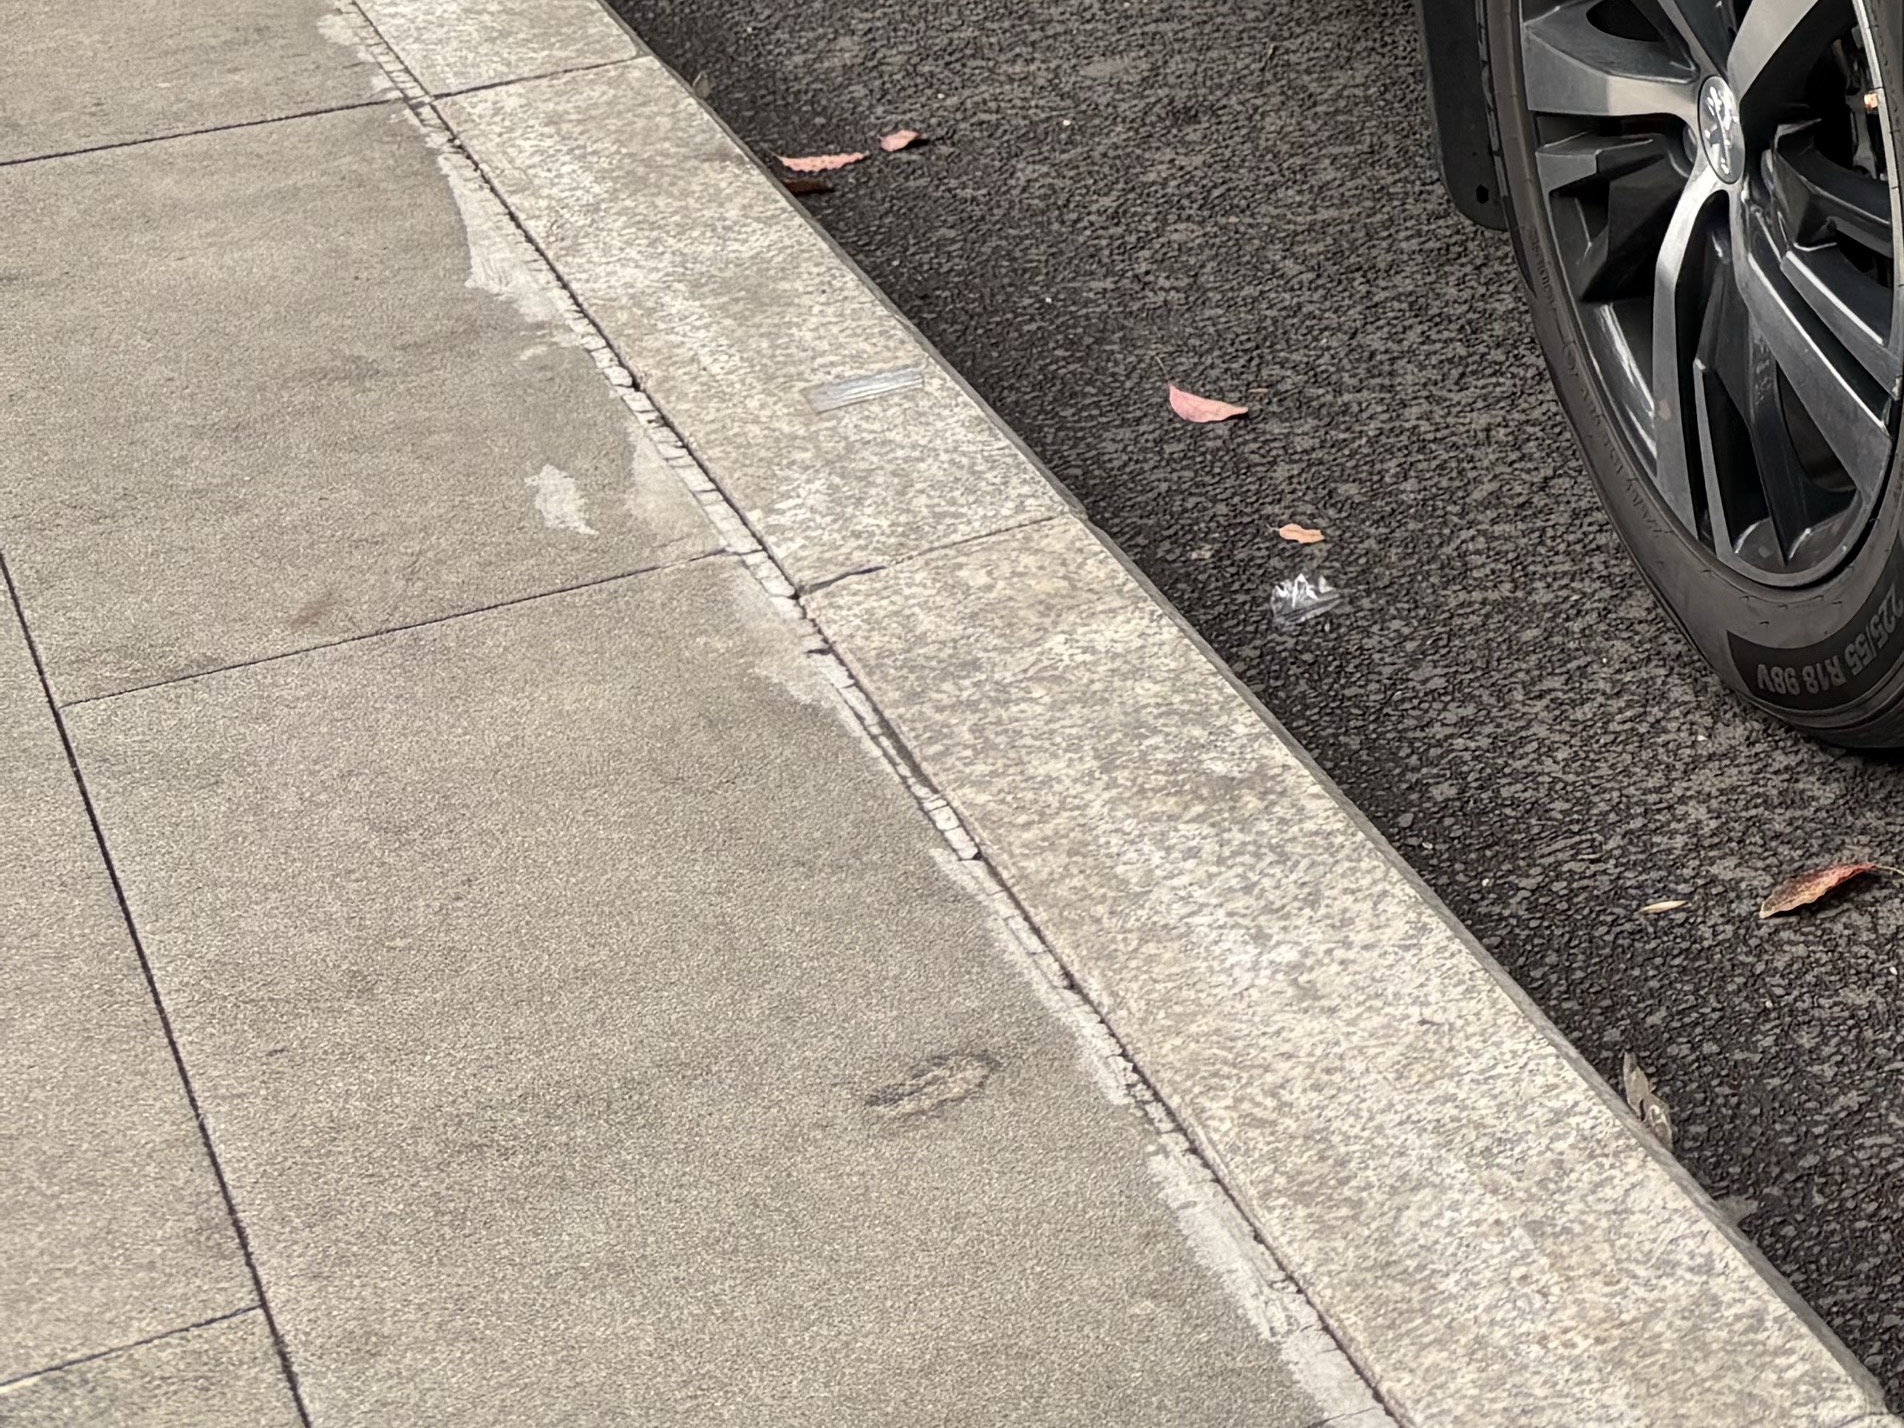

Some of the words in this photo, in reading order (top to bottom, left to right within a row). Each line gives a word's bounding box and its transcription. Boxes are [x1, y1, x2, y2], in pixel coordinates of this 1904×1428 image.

[1844, 581, 1904, 676] 225/55
[1756, 663, 1800, 696] 98V
[1802, 654, 1847, 695] R18
